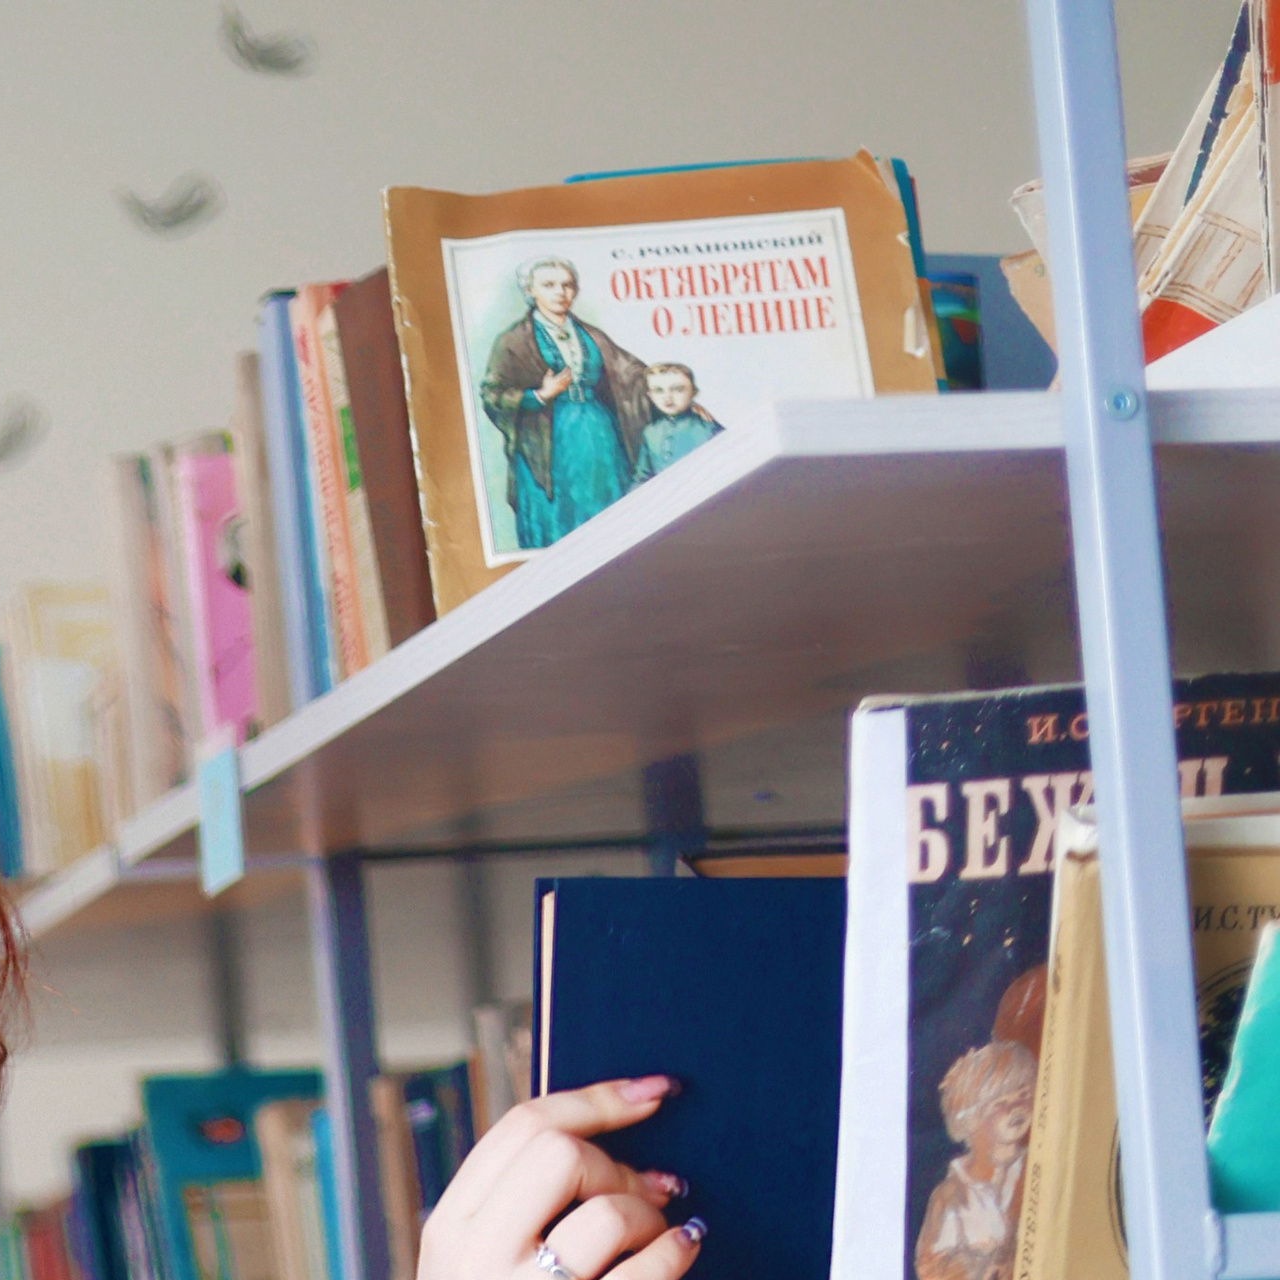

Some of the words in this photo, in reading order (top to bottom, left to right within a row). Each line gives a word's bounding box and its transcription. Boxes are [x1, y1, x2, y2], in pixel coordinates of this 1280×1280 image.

[609, 255, 832, 303] ОКТЯБРЯТАМ
[652, 308, 675, 339] О
[681, 296, 837, 338] ЛЕНИНЕ
